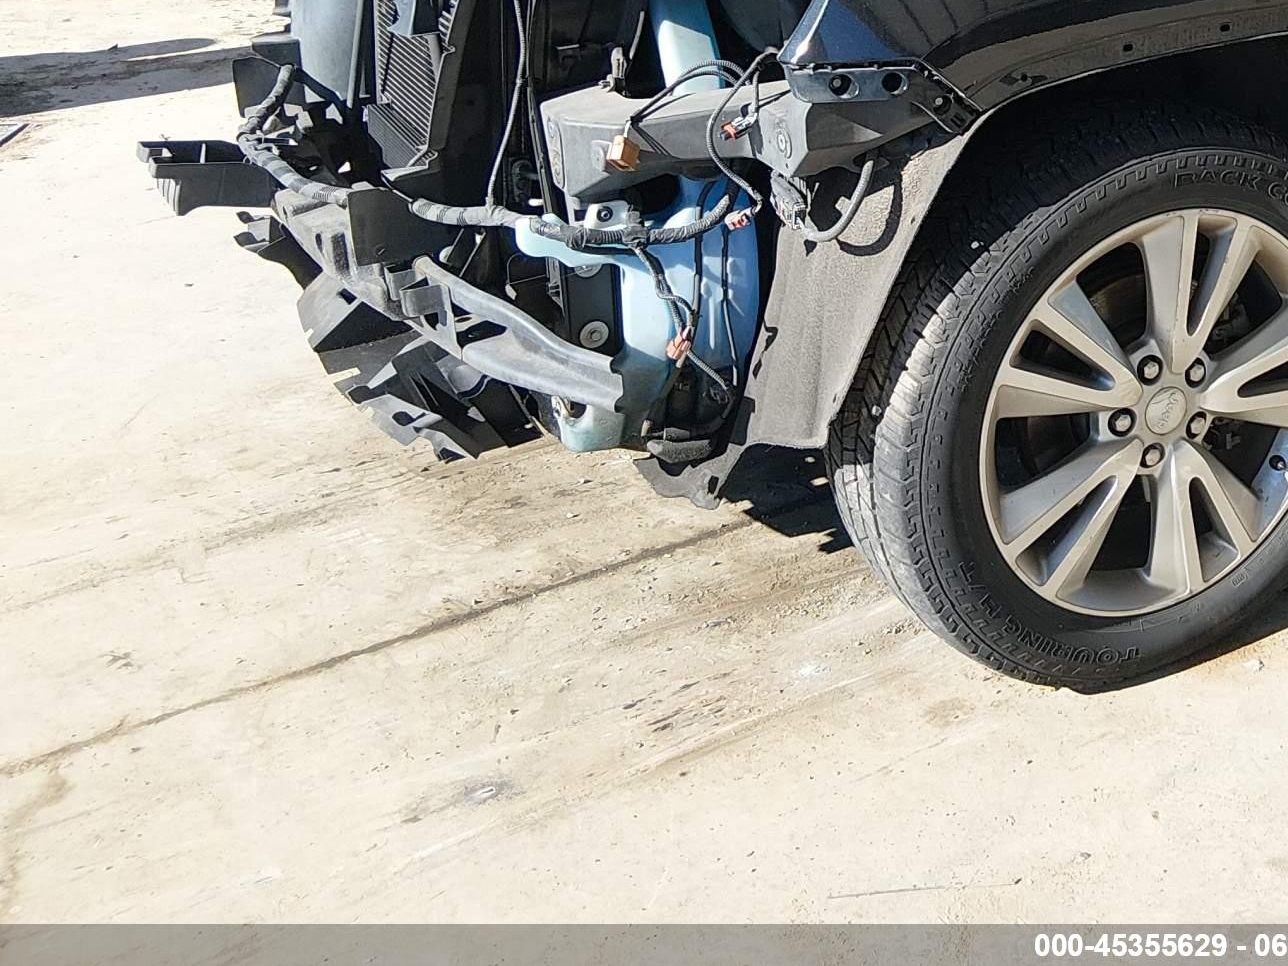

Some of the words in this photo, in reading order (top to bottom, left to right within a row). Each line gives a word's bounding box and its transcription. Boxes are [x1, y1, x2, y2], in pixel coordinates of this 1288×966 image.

[1174, 168, 1264, 190] BACK
[958, 560, 1003, 618] H/T
[1000, 614, 1142, 666] TOURING
